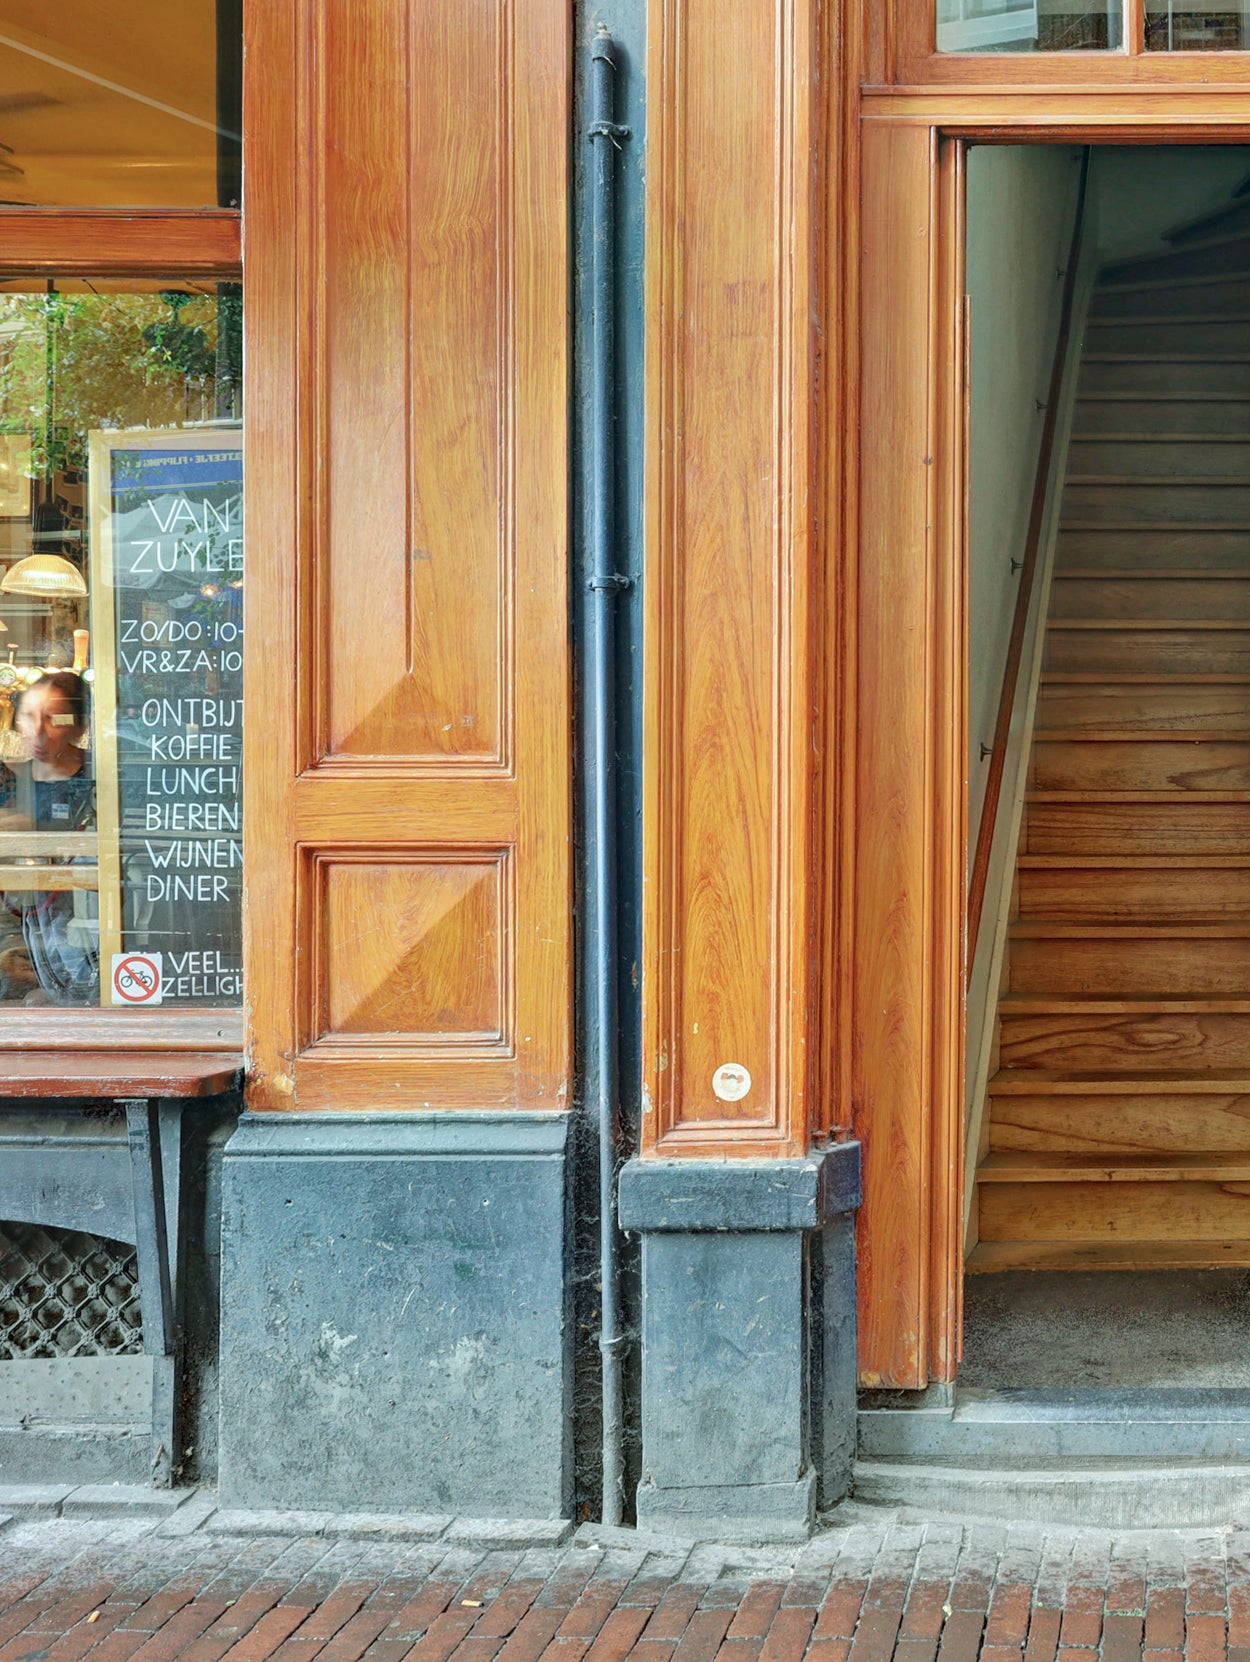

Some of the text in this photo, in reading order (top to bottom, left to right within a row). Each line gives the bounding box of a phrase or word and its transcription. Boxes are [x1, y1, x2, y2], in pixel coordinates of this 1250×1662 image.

[147, 498, 230, 534] VAN
[151, 733, 233, 761] KOFFIE
[146, 766, 237, 796] LUNCH
[145, 802, 239, 831] BIEREN
[146, 874, 230, 902] DINER
